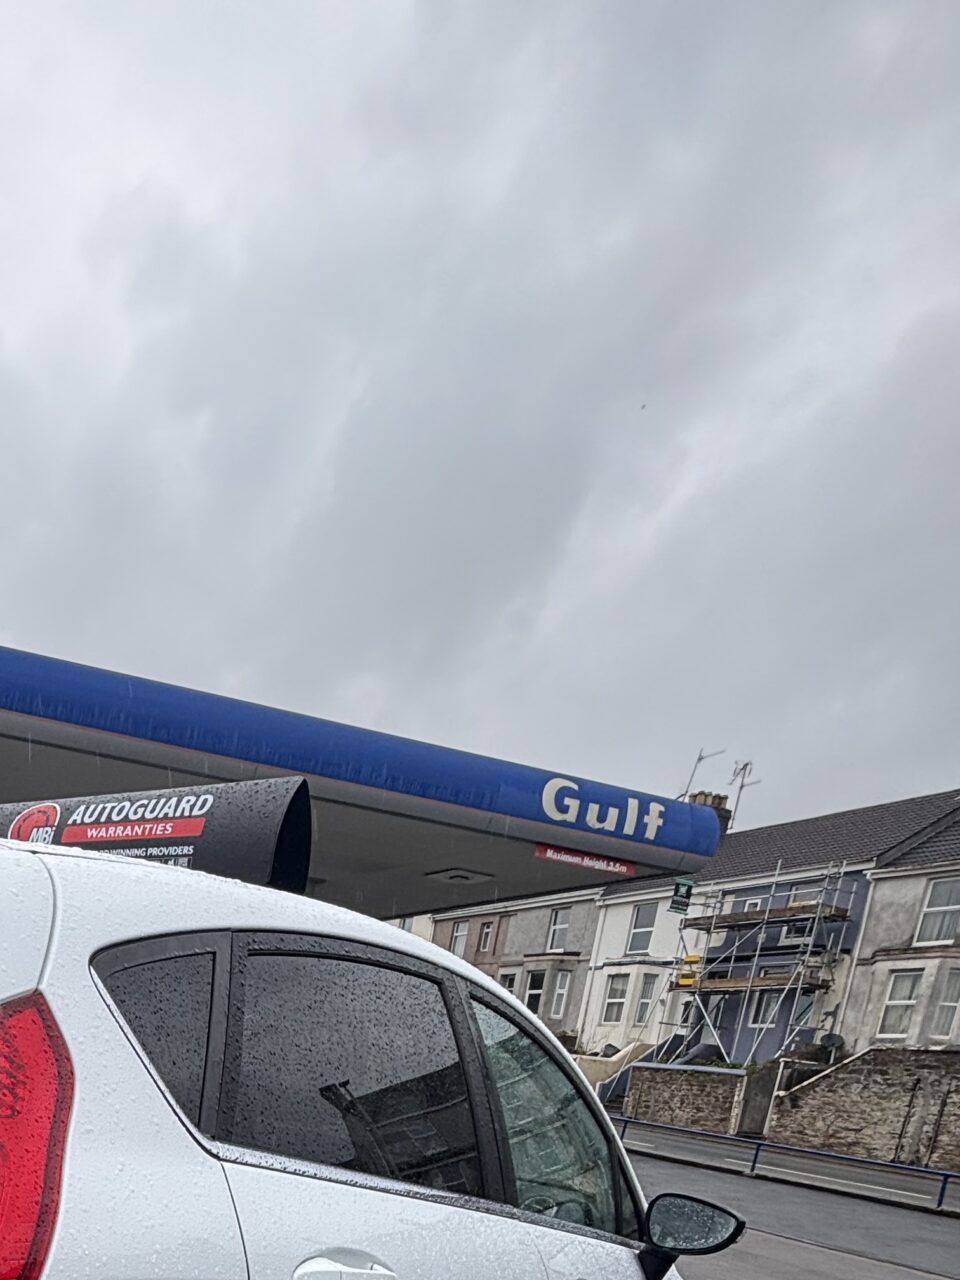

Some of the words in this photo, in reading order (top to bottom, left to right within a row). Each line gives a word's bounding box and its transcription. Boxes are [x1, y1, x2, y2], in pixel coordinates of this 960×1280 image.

[67, 794, 214, 825] AUTOGUARD
[542, 778, 665, 840] Gulf
[87, 823, 173, 839] WARRANTIES
[110, 847, 146, 857] WINNING
[147, 845, 194, 857] PROVIDERS
[546, 848, 582, 864] Maximum
[582, 856, 608, 871] Height
